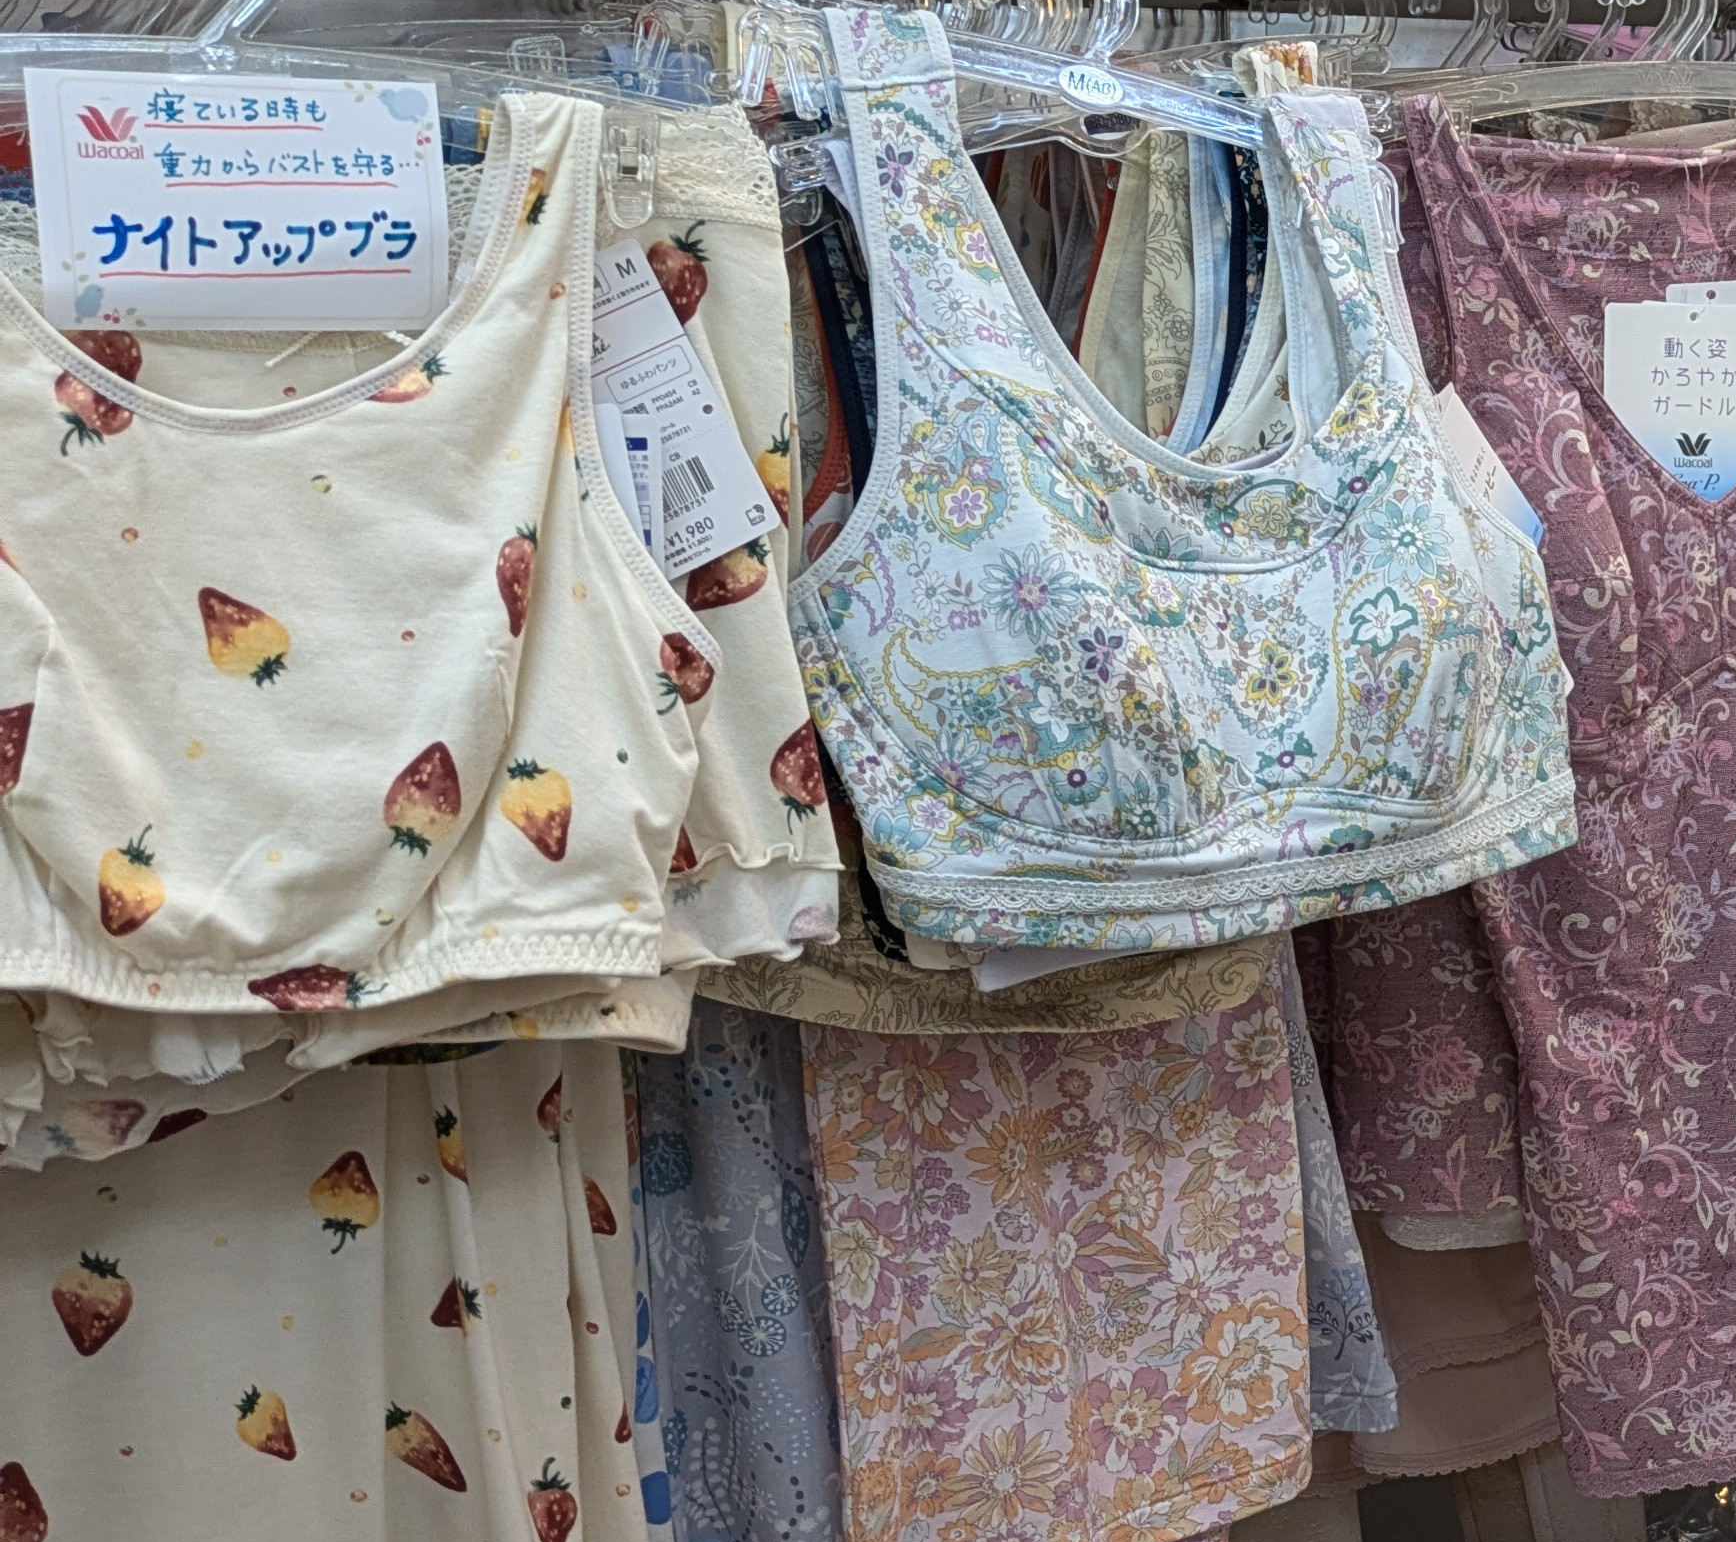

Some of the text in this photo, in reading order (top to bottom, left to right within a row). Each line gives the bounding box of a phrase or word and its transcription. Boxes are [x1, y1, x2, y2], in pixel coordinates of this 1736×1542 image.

[147, 87, 328, 124] 寝ている時も
[76, 141, 145, 161] Wacoal
[92, 210, 418, 272] ナイトアップブラ
[614, 257, 638, 280] M
[1664, 337, 1728, 360] 動く姿
[620, 357, 678, 391] ゆるふわパンツ
[1653, 395, 1736, 416] ガードル
[1673, 457, 1714, 469] Wacoal
[665, 515, 716, 549] ¥1,980
